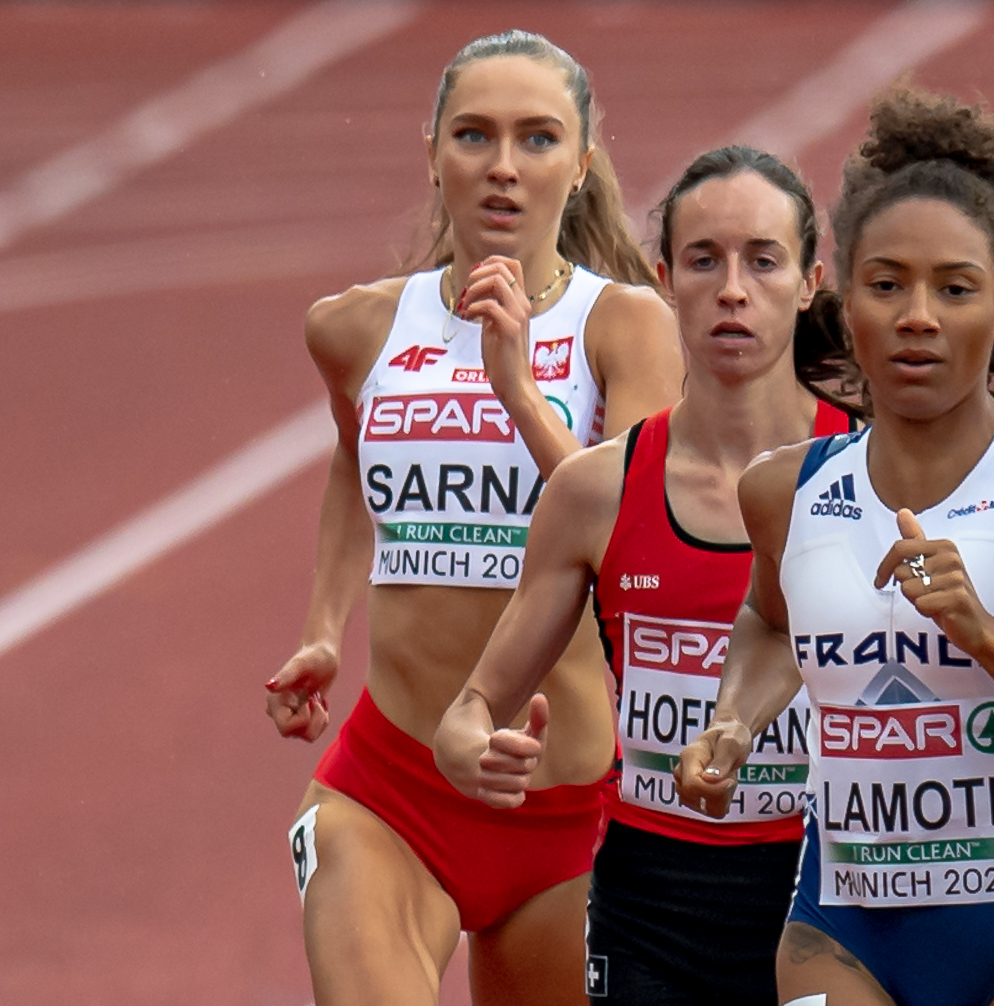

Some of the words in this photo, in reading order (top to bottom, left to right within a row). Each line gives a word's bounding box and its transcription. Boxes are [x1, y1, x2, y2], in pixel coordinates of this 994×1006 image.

[388, 345, 448, 372] 4F
[455, 371, 489, 382] ORL
[370, 399, 511, 436] SPAR
[810, 500, 863, 520] adidas
[406, 525, 443, 541] RUN
[378, 549, 470, 578] MUNICH
[482, 553, 519, 579] 20
[633, 575, 660, 590] UBS
[633, 627, 731, 670] SPA
[795, 631, 983, 668] FRANC
[823, 713, 957, 751] SPAR
[861, 845, 901, 862] RUN
[834, 868, 931, 898] MUNICH
